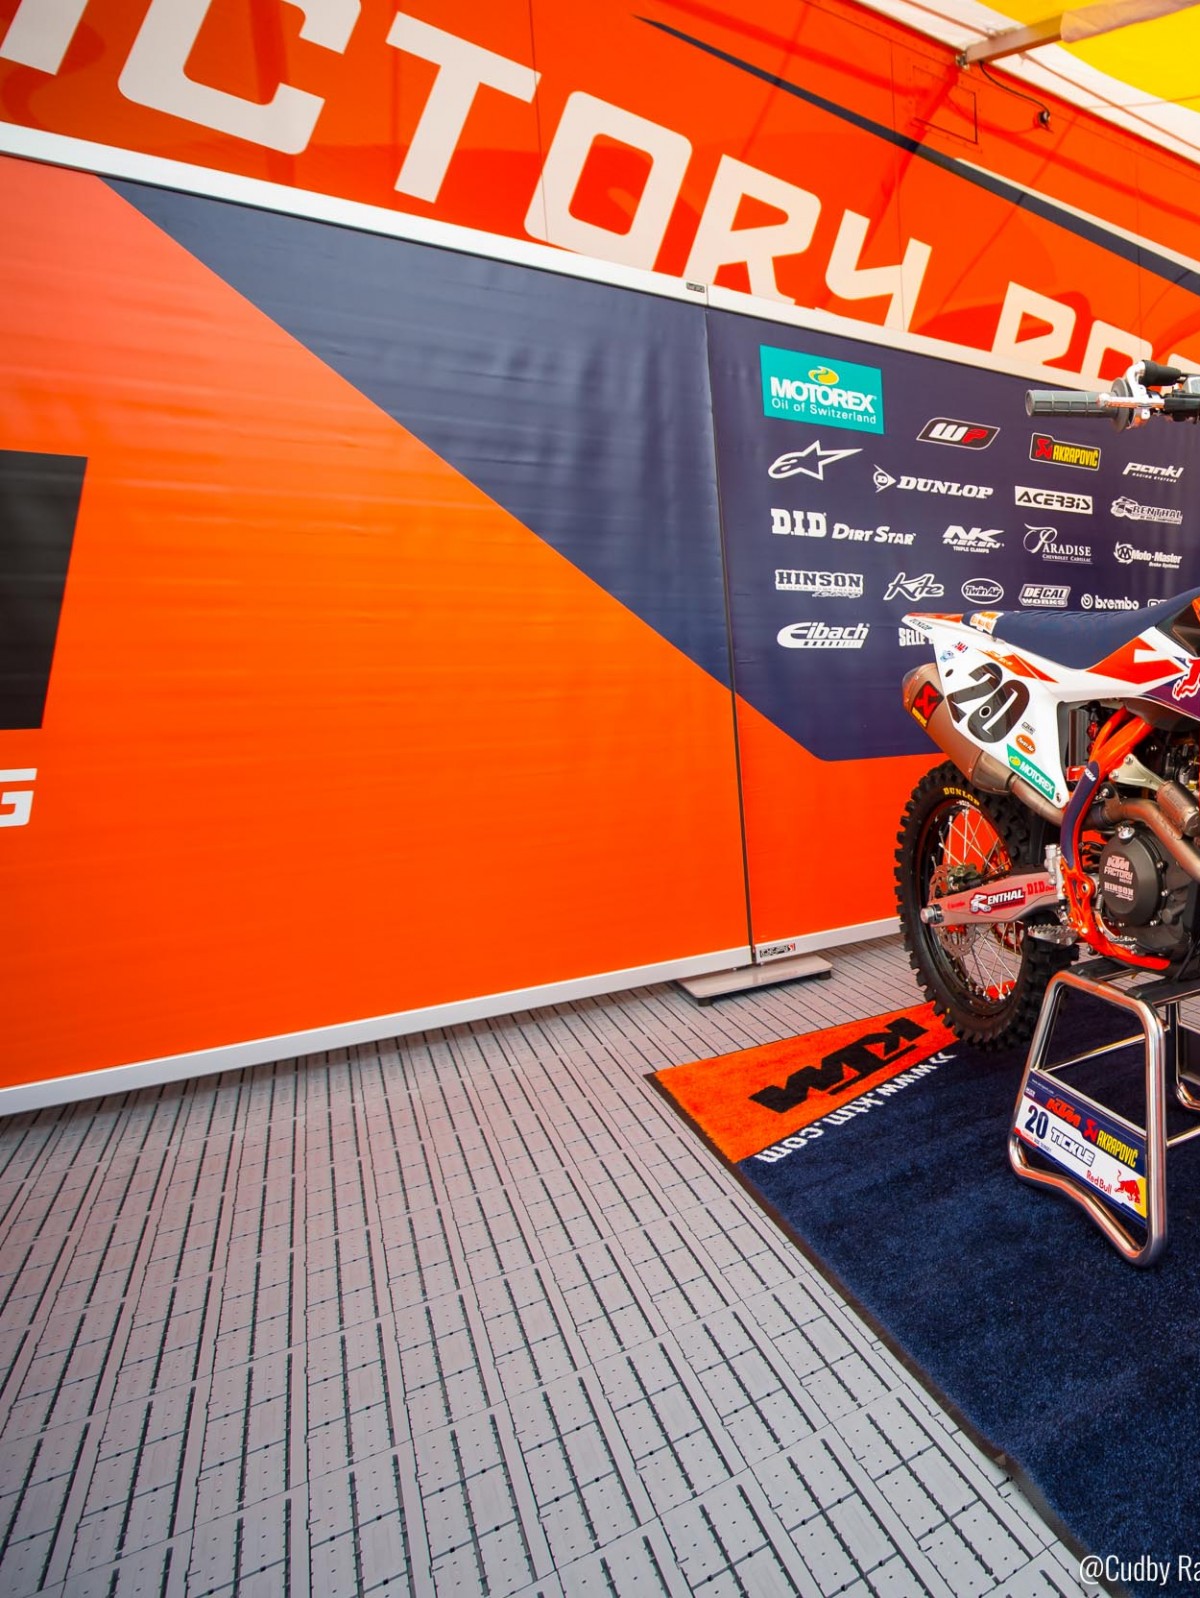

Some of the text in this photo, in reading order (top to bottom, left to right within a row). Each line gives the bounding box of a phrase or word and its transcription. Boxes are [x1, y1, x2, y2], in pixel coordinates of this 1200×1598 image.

[770, 376, 875, 413] MOTOREX
[771, 397, 877, 425] Oil of Switzerland
[1122, 462, 1184, 479] pankl
[896, 475, 994, 499] DUNLOP
[1133, 505, 1183, 519] RENTHAL
[943, 538, 1001, 549] NEKEN
[1023, 523, 1092, 557] PARADISE
[1131, 549, 1183, 564] Moto-Master
[777, 571, 863, 588] HINSON
[966, 584, 1001, 597] Twin Air
[1095, 595, 1139, 610] brembo
[777, 622, 869, 648] Eibach
[946, 662, 1030, 743] 20
[1020, 762, 1054, 795] MOTOREX
[943, 787, 980, 806] DUNLOP
[748, 1017, 929, 1113] KTM
[754, 1061, 938, 1163] www.ktm.com
[1025, 1105, 1049, 1140] 20
[1046, 1095, 1082, 1127] KTM
[1051, 1126, 1096, 1167] TICKLE
[1086, 1170, 1112, 1194] Red Bull
